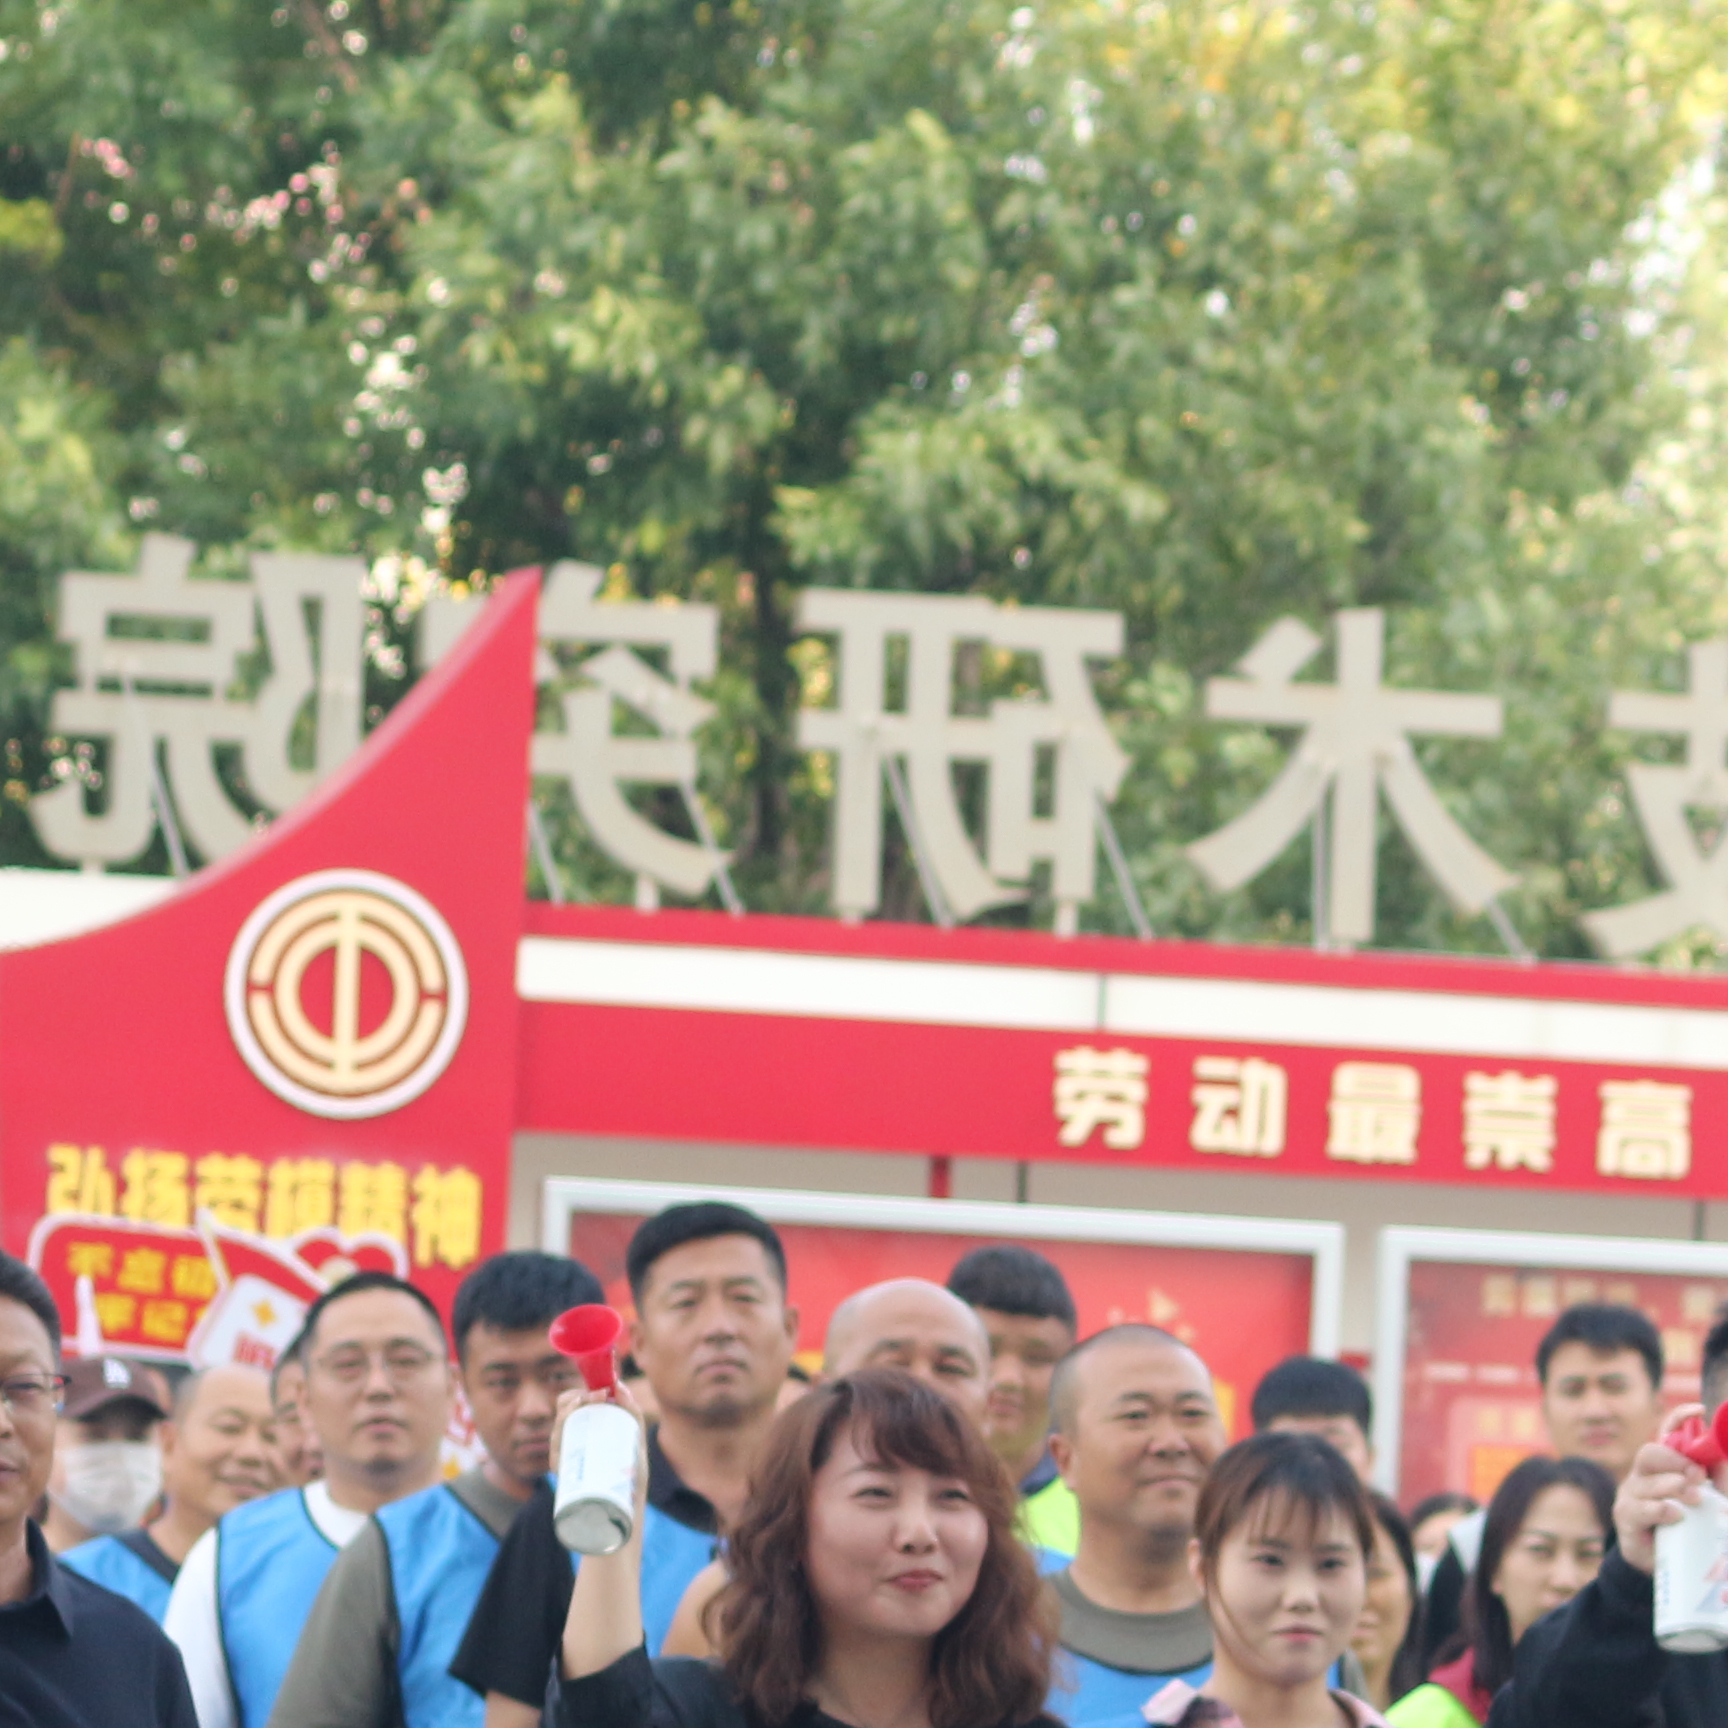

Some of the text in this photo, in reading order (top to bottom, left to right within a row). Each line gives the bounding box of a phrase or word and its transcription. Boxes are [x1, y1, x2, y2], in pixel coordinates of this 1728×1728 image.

[1053, 1047, 1692, 1179] 劳动最崇高
[46, 1142, 482, 1270] 弘扬劳模精神
